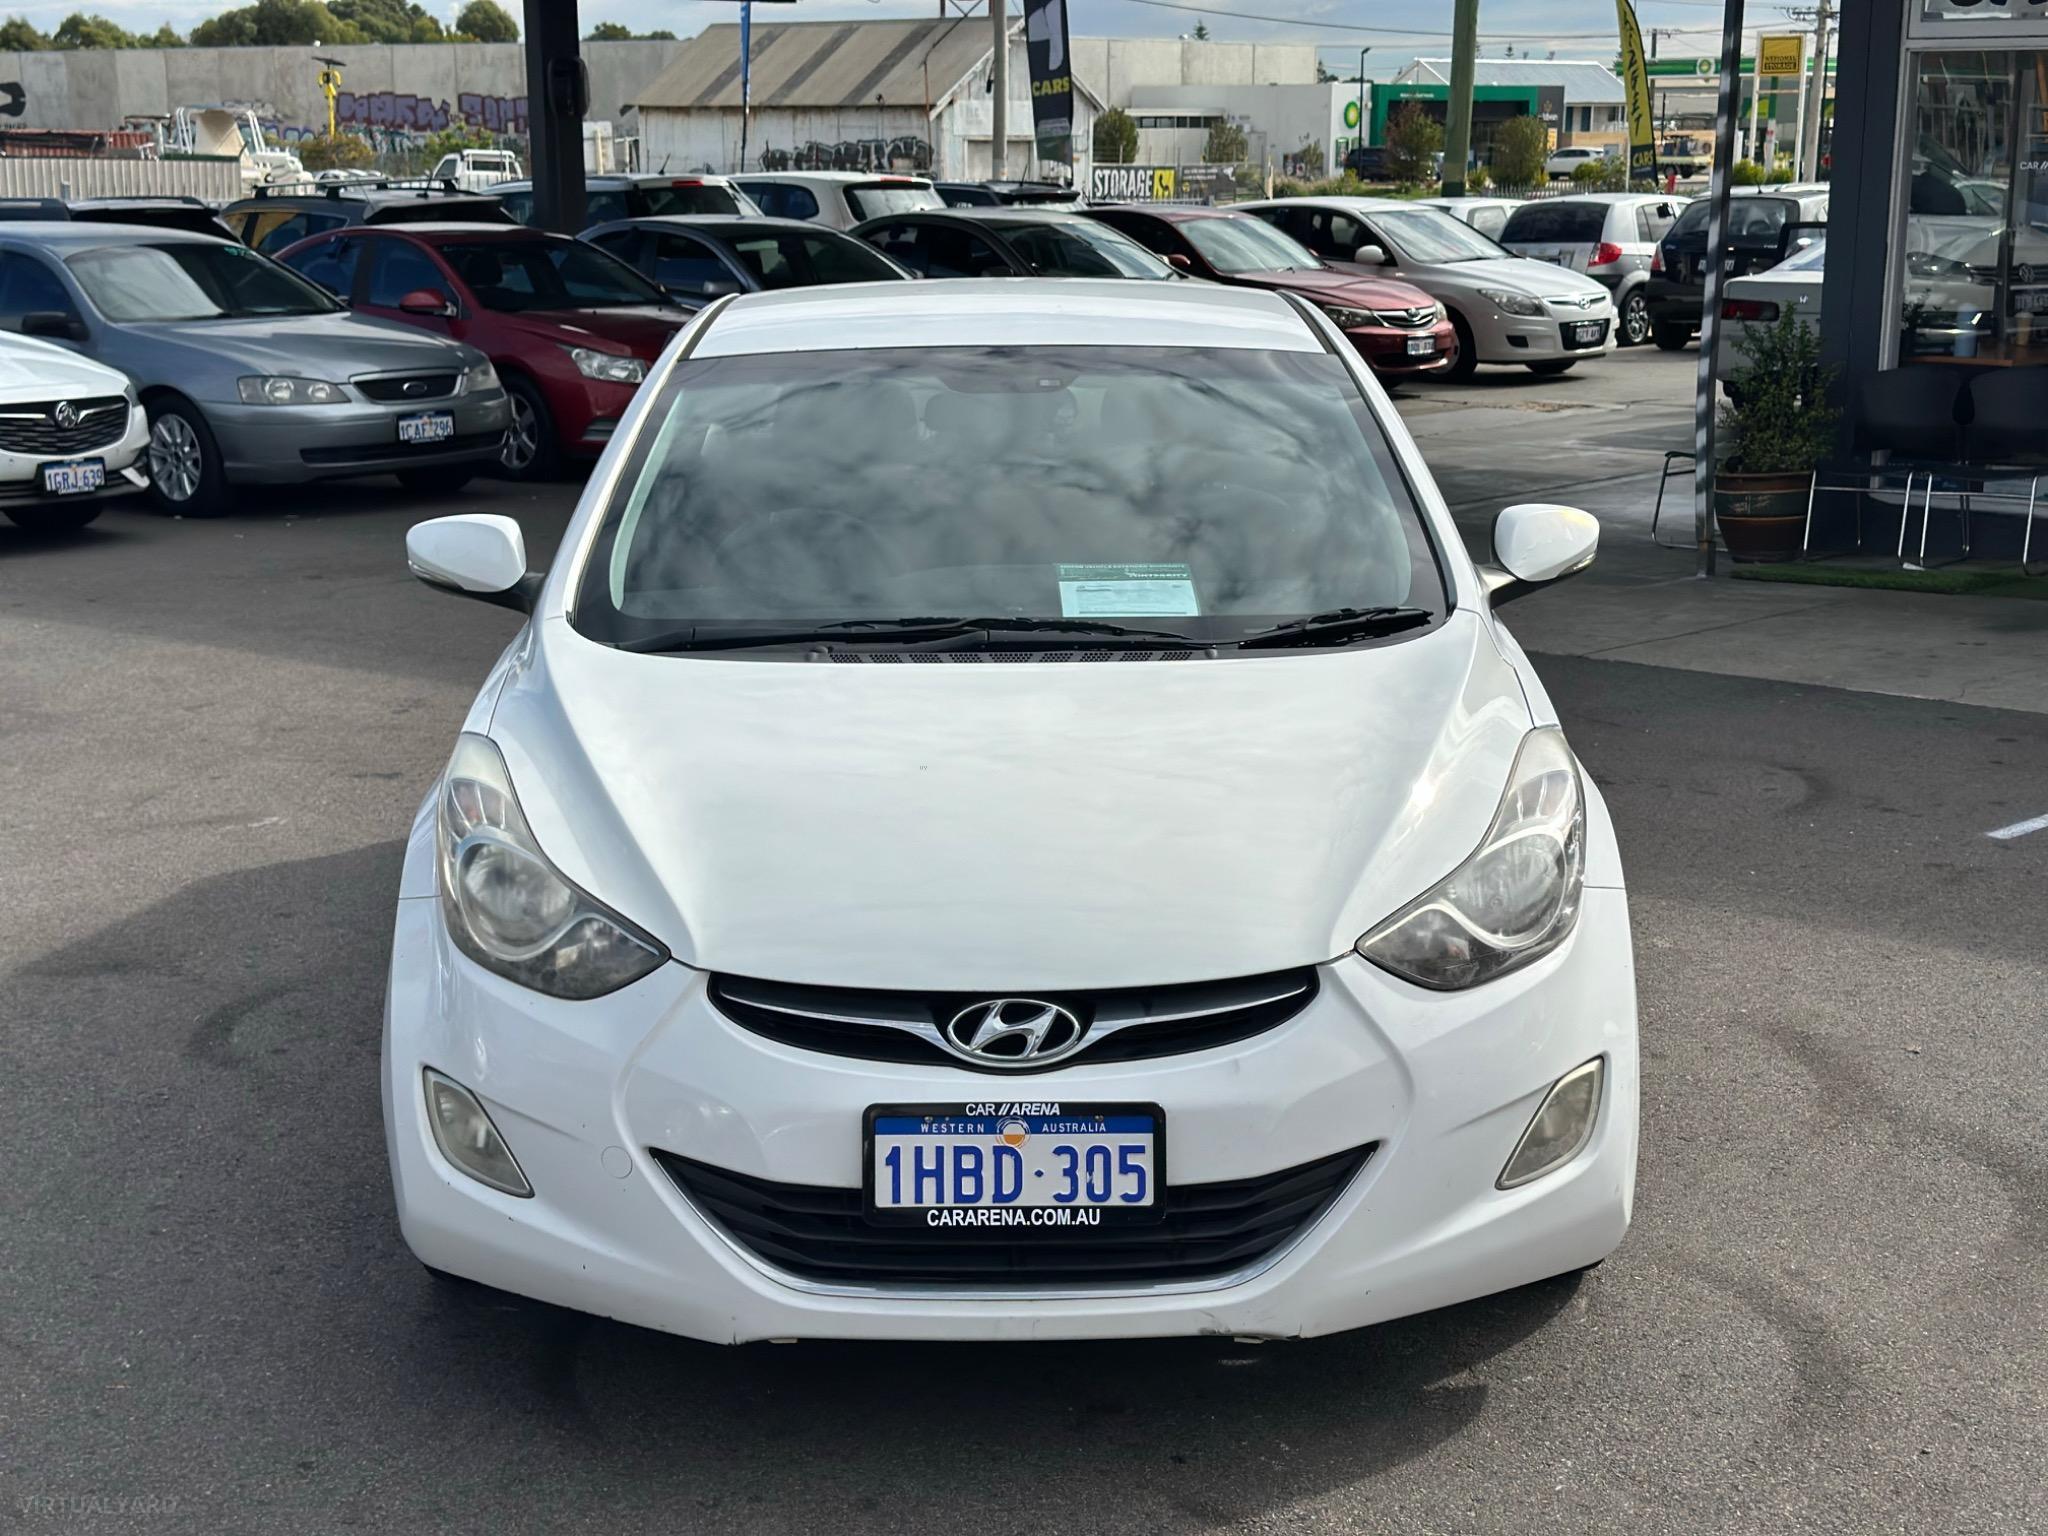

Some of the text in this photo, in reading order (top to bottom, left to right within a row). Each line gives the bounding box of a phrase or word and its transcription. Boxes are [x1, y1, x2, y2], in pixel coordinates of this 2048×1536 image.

[1032, 77, 1070, 97] CARS
[1632, 152, 1653, 167] CARS
[2020, 161, 2039, 170] CAR
[1094, 169, 1153, 198] STORAGE
[920, 1122, 1107, 1134] WESTERN AUSTRALIA
[926, 1208, 1101, 1227] CARARENA.COM.AU
